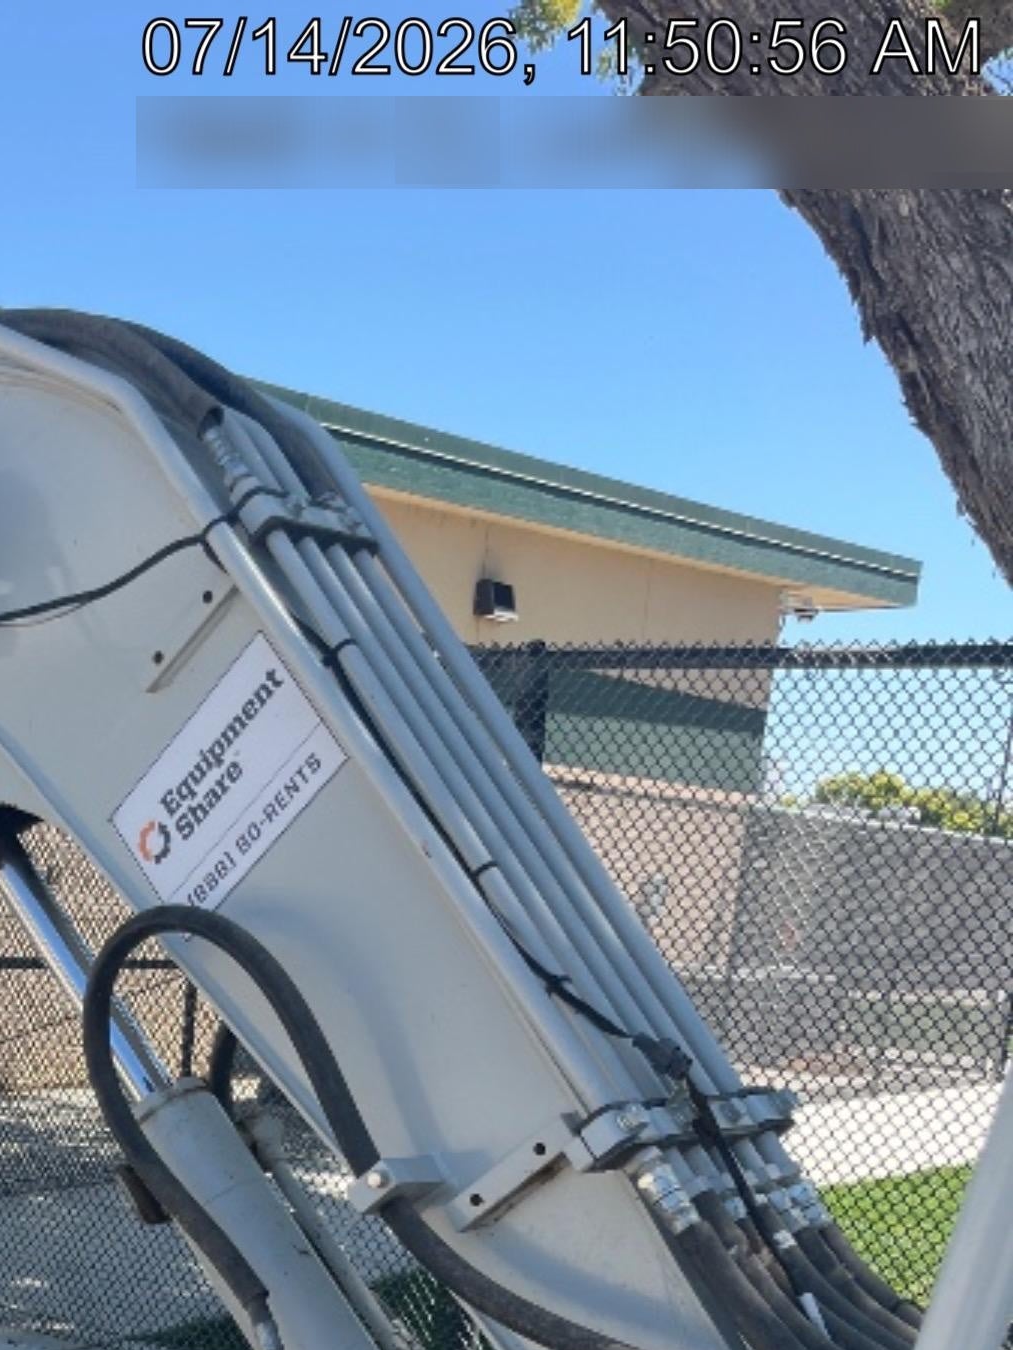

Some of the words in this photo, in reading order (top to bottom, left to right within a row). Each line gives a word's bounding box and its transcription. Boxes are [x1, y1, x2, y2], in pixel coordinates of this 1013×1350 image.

[159, 667, 285, 819] Equipment
[174, 759, 244, 842] Share
[234, 751, 323, 857] 80-RENTS
